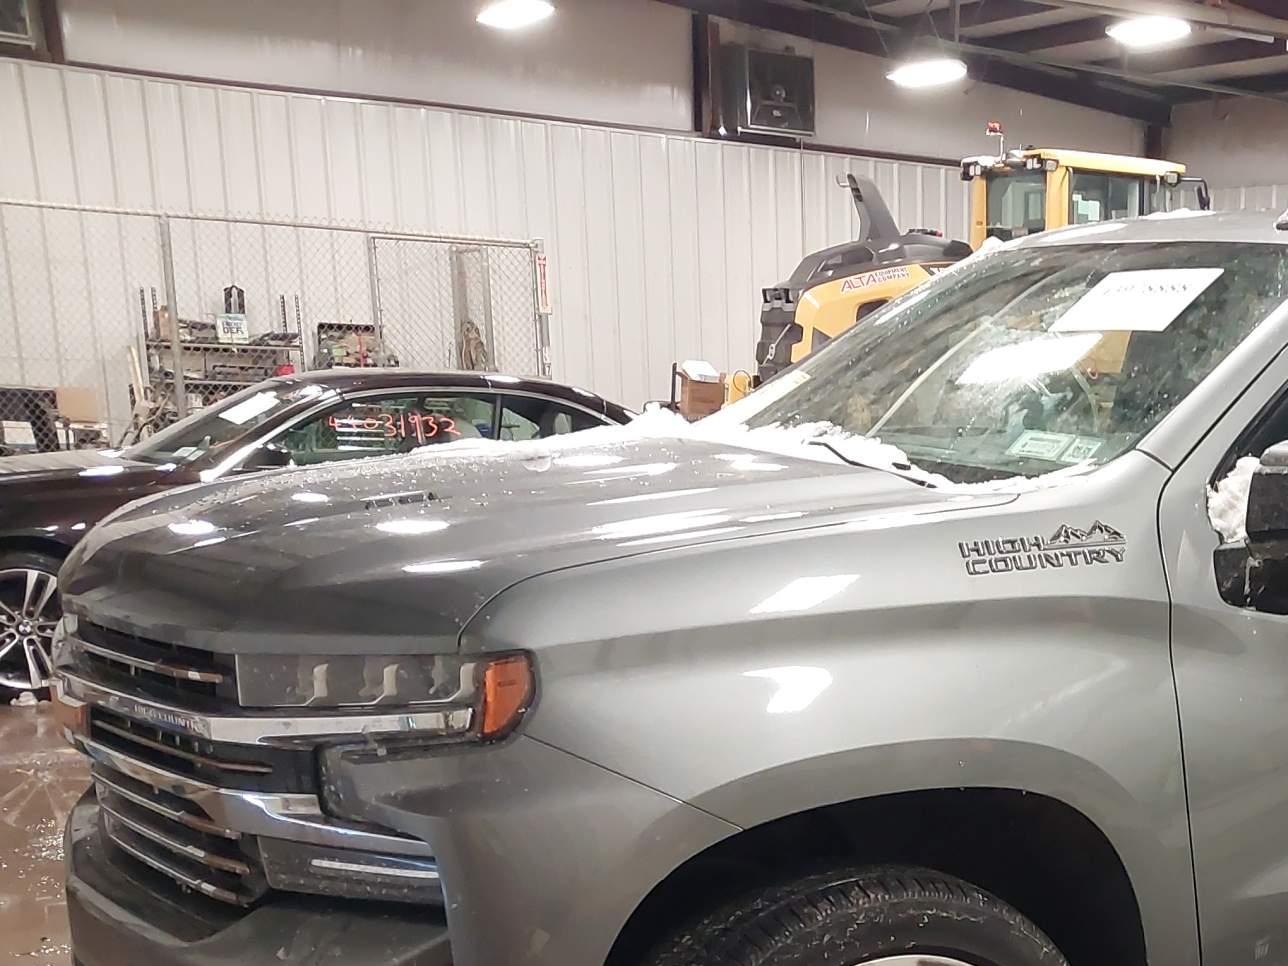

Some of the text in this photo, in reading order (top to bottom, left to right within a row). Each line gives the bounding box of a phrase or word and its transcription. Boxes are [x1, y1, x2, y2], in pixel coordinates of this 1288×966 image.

[841, 273, 876, 293] ALTA
[958, 536, 1045, 558] HIGH
[965, 548, 1127, 575] COUNTRY
